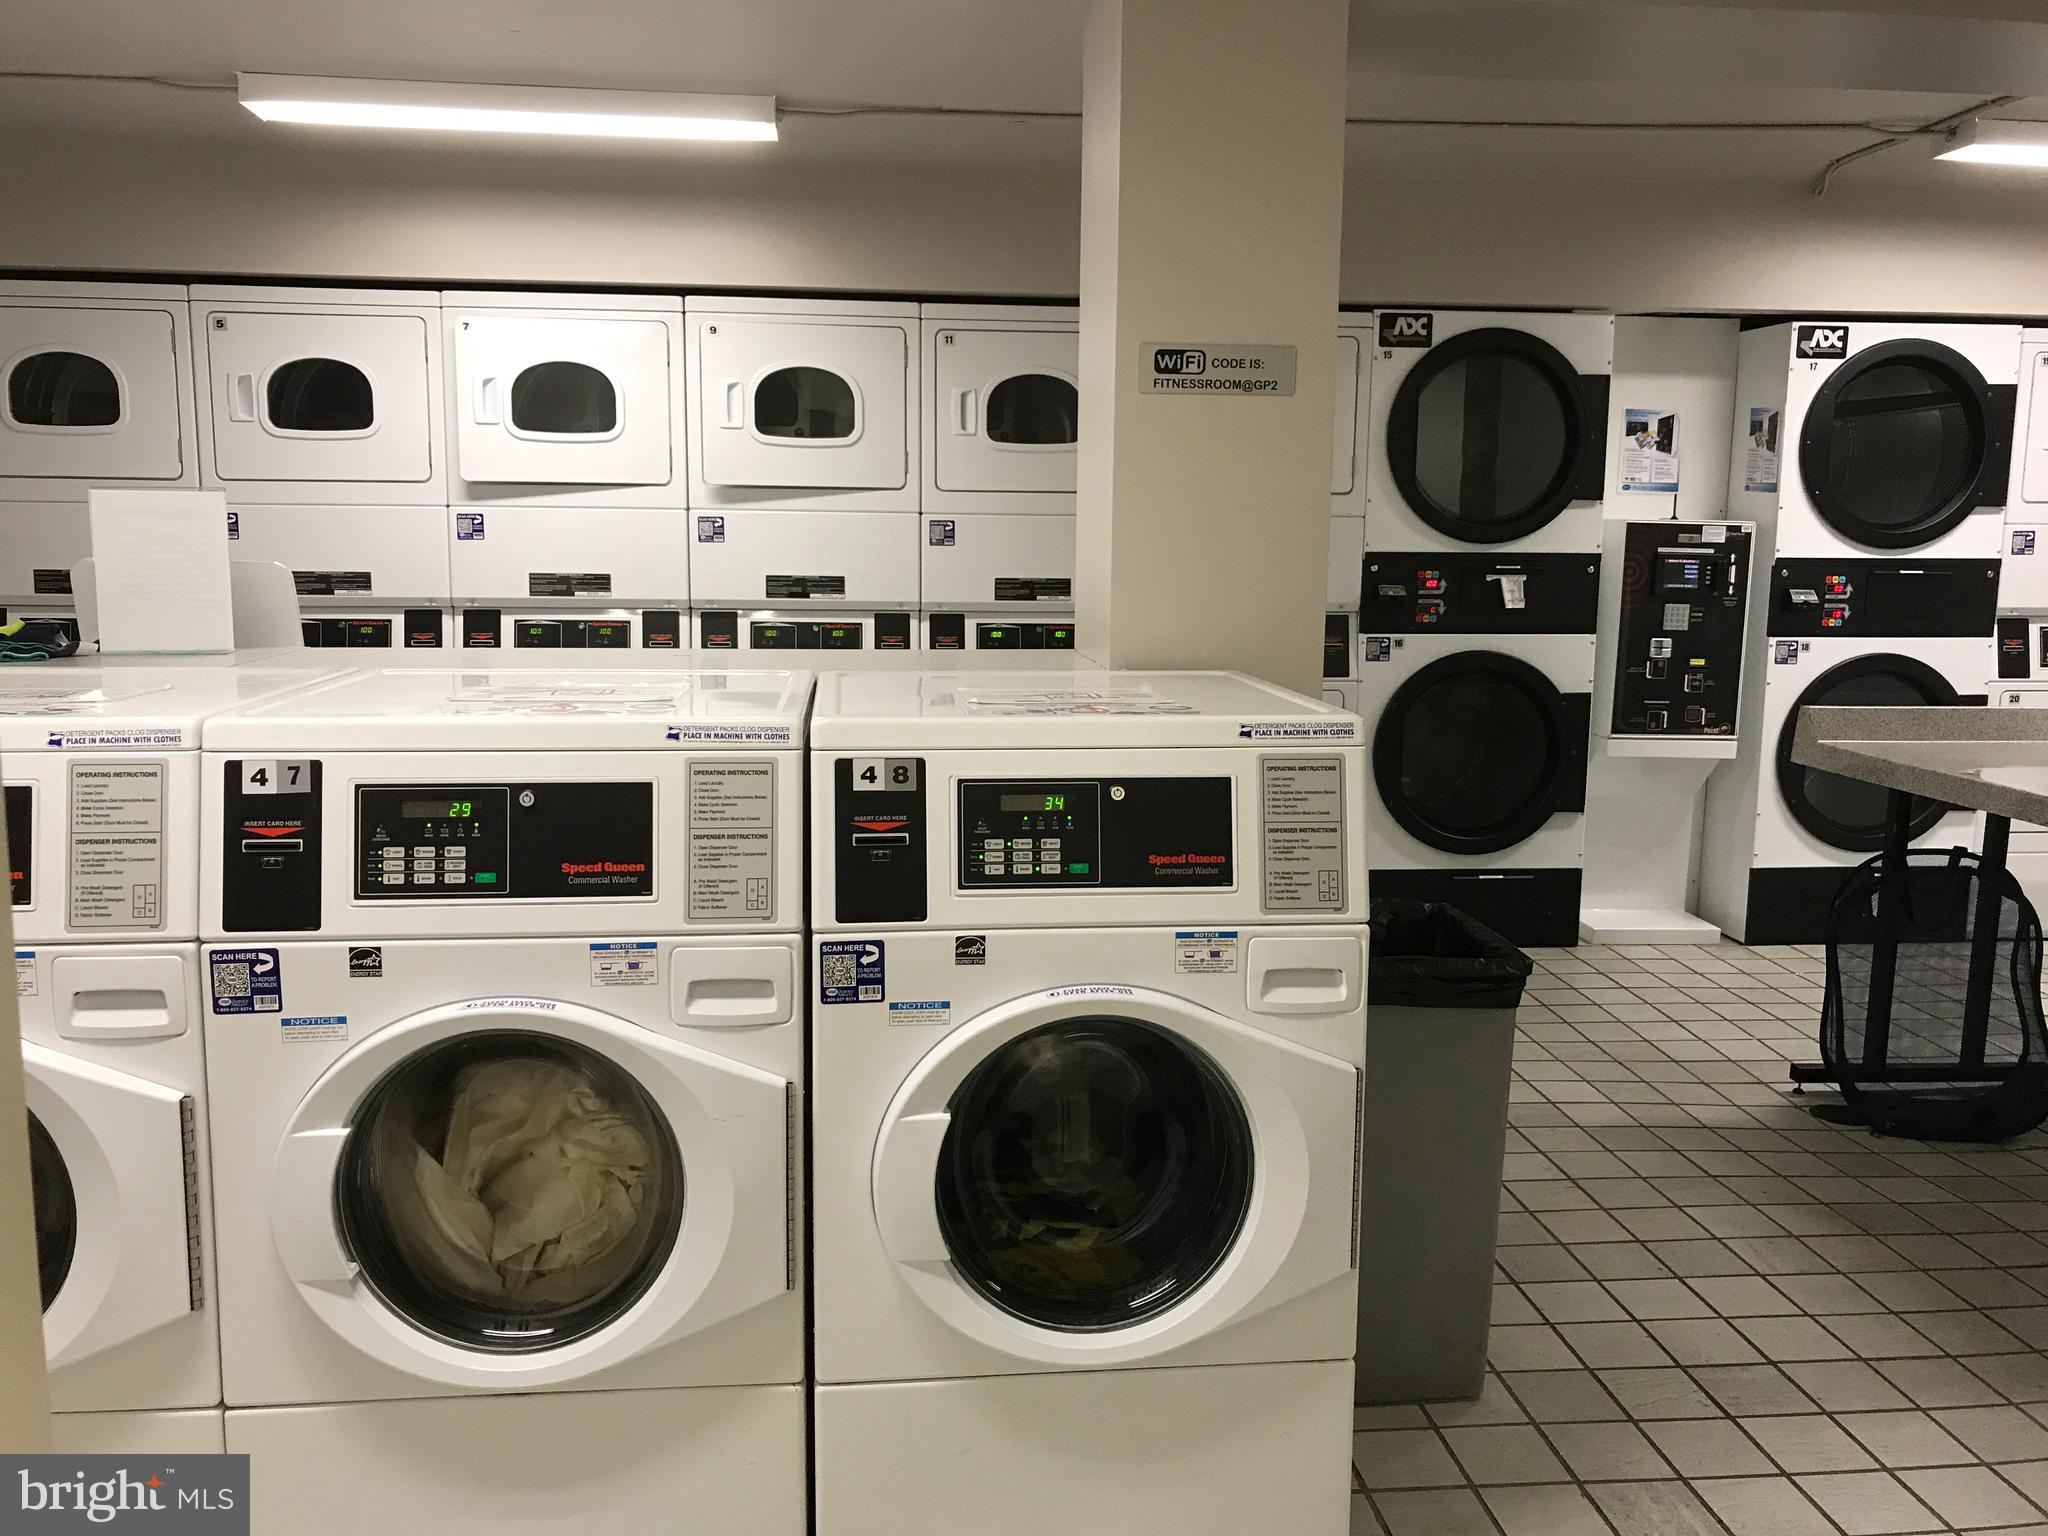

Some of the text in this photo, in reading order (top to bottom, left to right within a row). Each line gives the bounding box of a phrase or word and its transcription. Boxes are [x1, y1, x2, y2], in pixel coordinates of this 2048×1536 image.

[216, 320, 224, 328] 5
[462, 322, 469, 330] 7
[1392, 316, 1428, 336] ADC
[710, 326, 717, 334] 9
[944, 336, 953, 344] 11
[1809, 328, 1844, 348] ADC
[1384, 351, 1392, 359] 15
[1211, 358, 1247, 369] CODE
[1249, 359, 1265, 370] IS:
[1809, 362, 1818, 370] 17
[1153, 378, 1278, 392] FITNESSROOM@GP2
[360, 626, 372, 634] 100
[2009, 695, 2020, 703] 20
[250, 766, 301, 786] 4 7
[860, 765, 910, 784] 4 8
[1045, 796, 1064, 810] 34
[450, 803, 472, 817] 29
[1148, 853, 1226, 865] Speed Queen
[561, 862, 645, 874] Speed Queen
[1155, 867, 1193, 875] Commercial
[568, 875, 638, 884] Commercial Washer
[212, 953, 234, 961] SCAN
[290, 1017, 338, 1025] NOTICE
